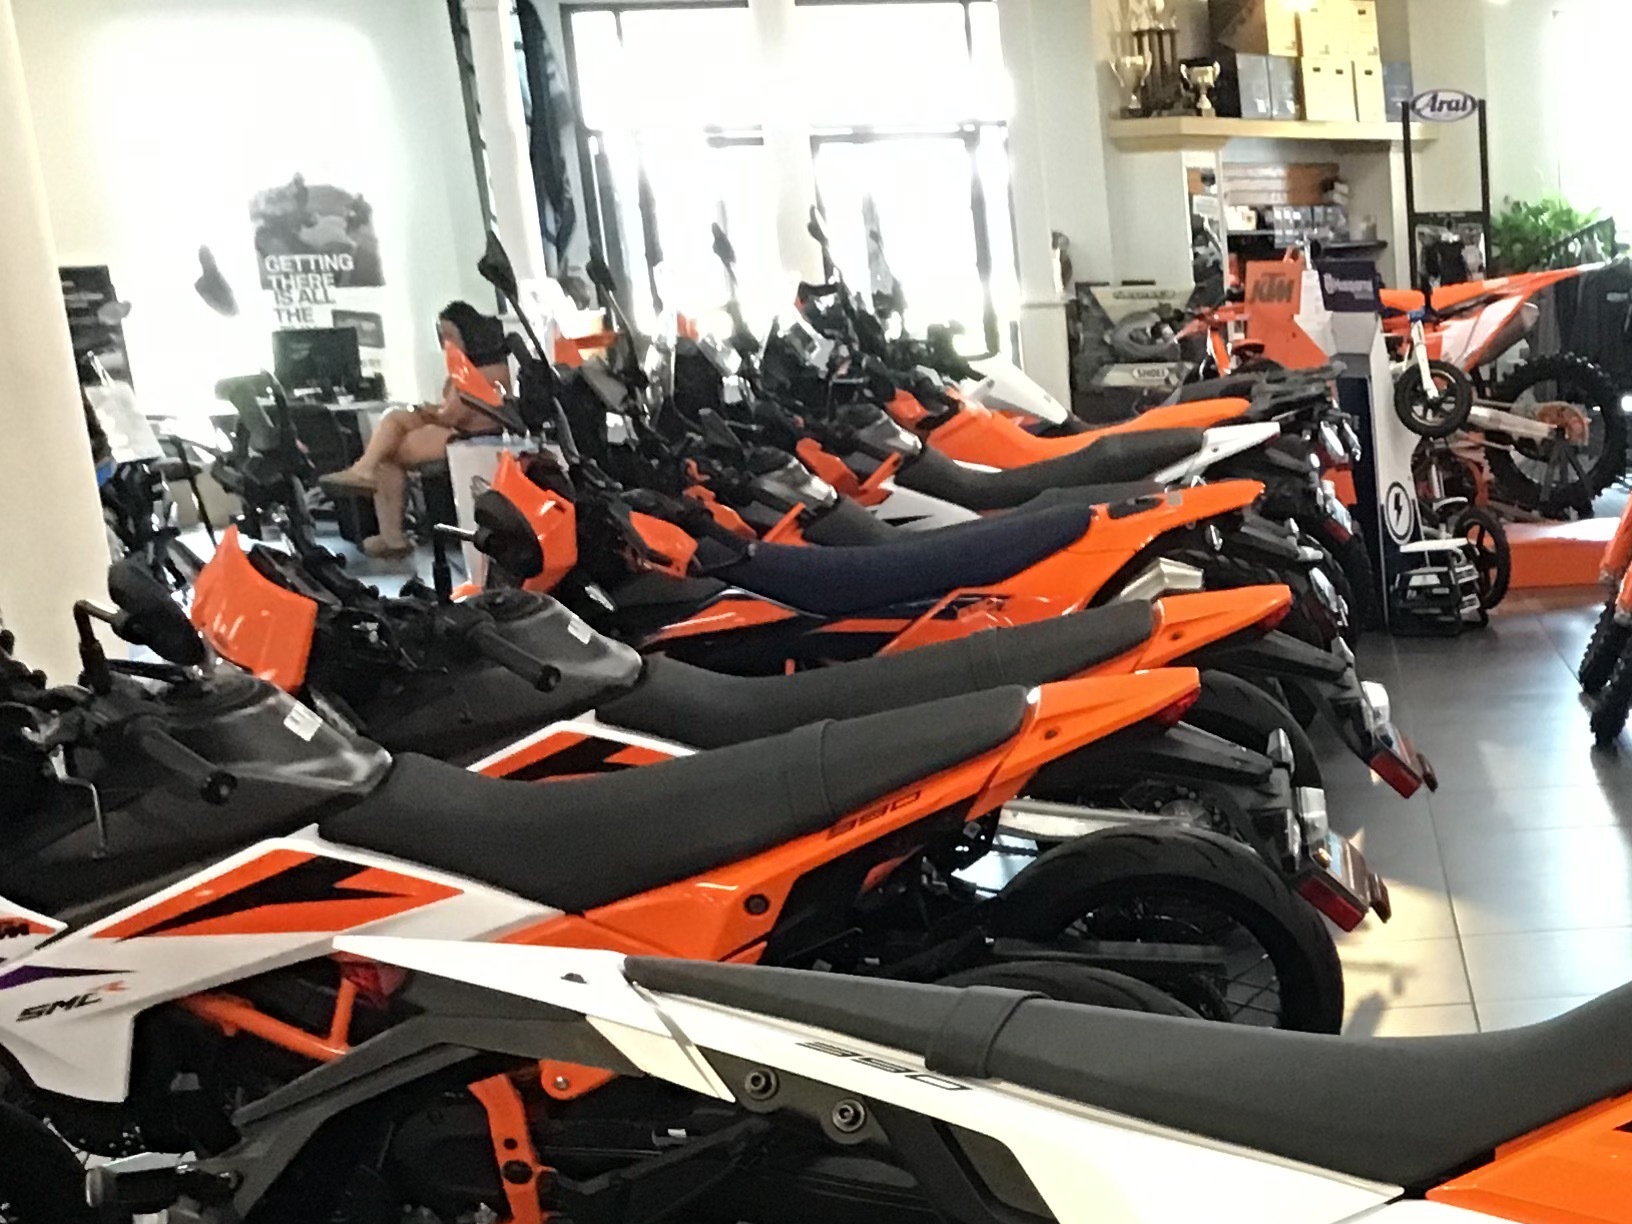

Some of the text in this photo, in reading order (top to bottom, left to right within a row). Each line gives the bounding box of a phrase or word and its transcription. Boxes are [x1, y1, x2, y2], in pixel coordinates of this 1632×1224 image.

[1415, 92, 1469, 113] Arai
[264, 254, 355, 272] GETTING
[267, 273, 335, 289] THERE
[1253, 272, 1295, 303] KTM
[273, 287, 336, 305] IS ALL
[273, 307, 314, 323] THE
